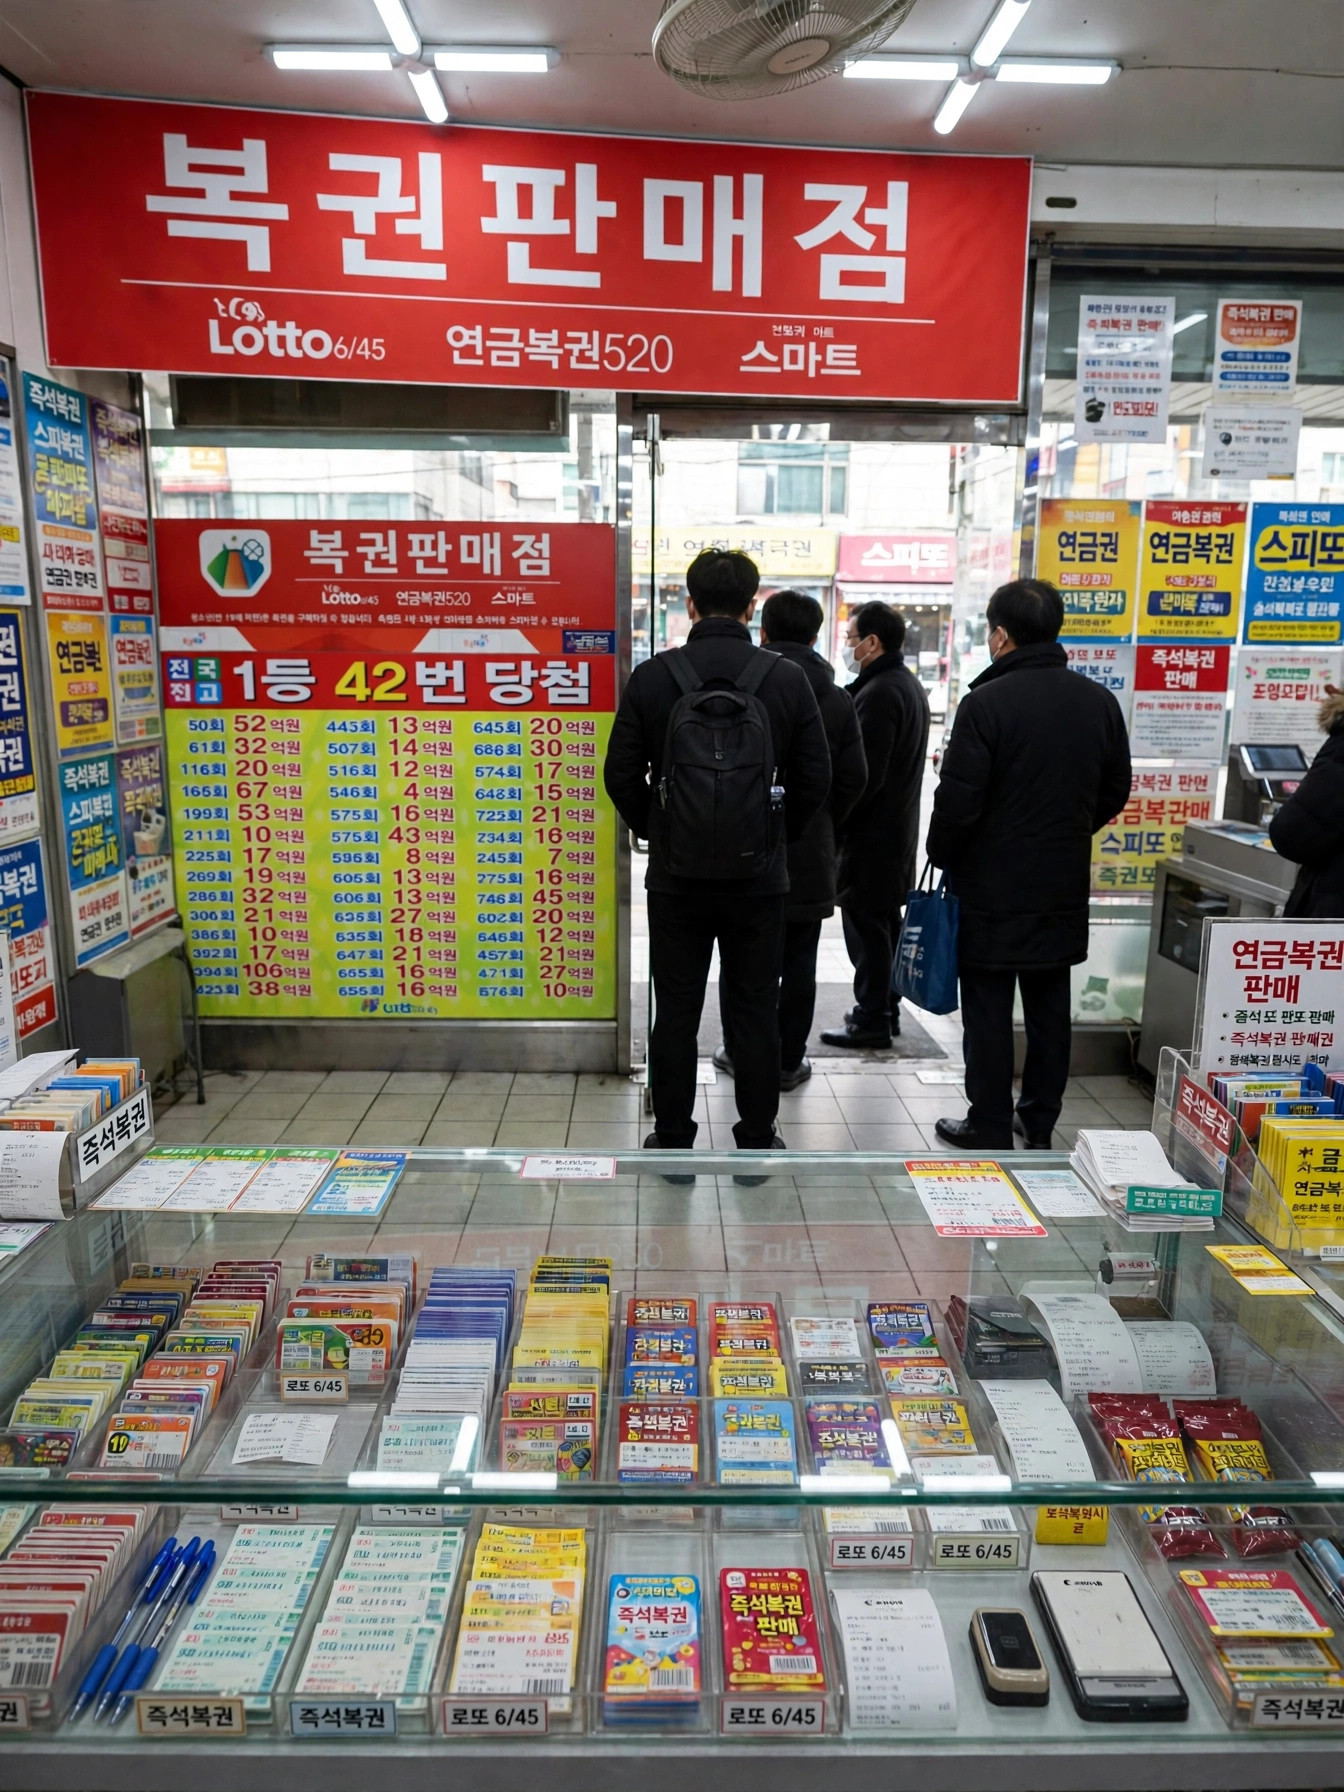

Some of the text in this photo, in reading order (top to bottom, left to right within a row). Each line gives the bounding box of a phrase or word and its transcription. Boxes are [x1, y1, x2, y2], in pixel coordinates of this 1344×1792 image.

[145, 132, 909, 304] 복권판매점
[739, 340, 862, 378] 스마트
[29, 380, 82, 424] 즉석복권
[303, 529, 551, 577] 복권판매점
[1057, 530, 1119, 563] 연금권
[1149, 531, 1235, 565] 연금복권
[491, 591, 536, 606] 스마트
[1152, 649, 1216, 669] 즉석복권
[233, 659, 317, 703] 1등
[485, 661, 591, 706] 당첨
[1164, 670, 1198, 689] 판매
[64, 760, 110, 792] 즉석복권
[1232, 939, 1344, 971] 연금복권
[1243, 974, 1301, 1005] 판매
[1181, 1083, 1231, 1146] 즉석복권
[82, 1097, 147, 1166] 즉석복권
[286, 1379, 343, 1393] 로또 6/45
[837, 1544, 907, 1560] 로또 6/45
[940, 1544, 1013, 1560] 로또 6/45
[617, 1606, 688, 1624] 즉석복권
[732, 1594, 804, 1617] 즉석복권
[756, 1616, 799, 1637] 판매
[146, 1704, 235, 1728] 즉석복권
[299, 1707, 386, 1729] 즉석복권
[451, 1708, 539, 1726] 로또 6/45
[728, 1707, 816, 1726] 로또 6/45
[1260, 1699, 1344, 1721] 즉석복권
